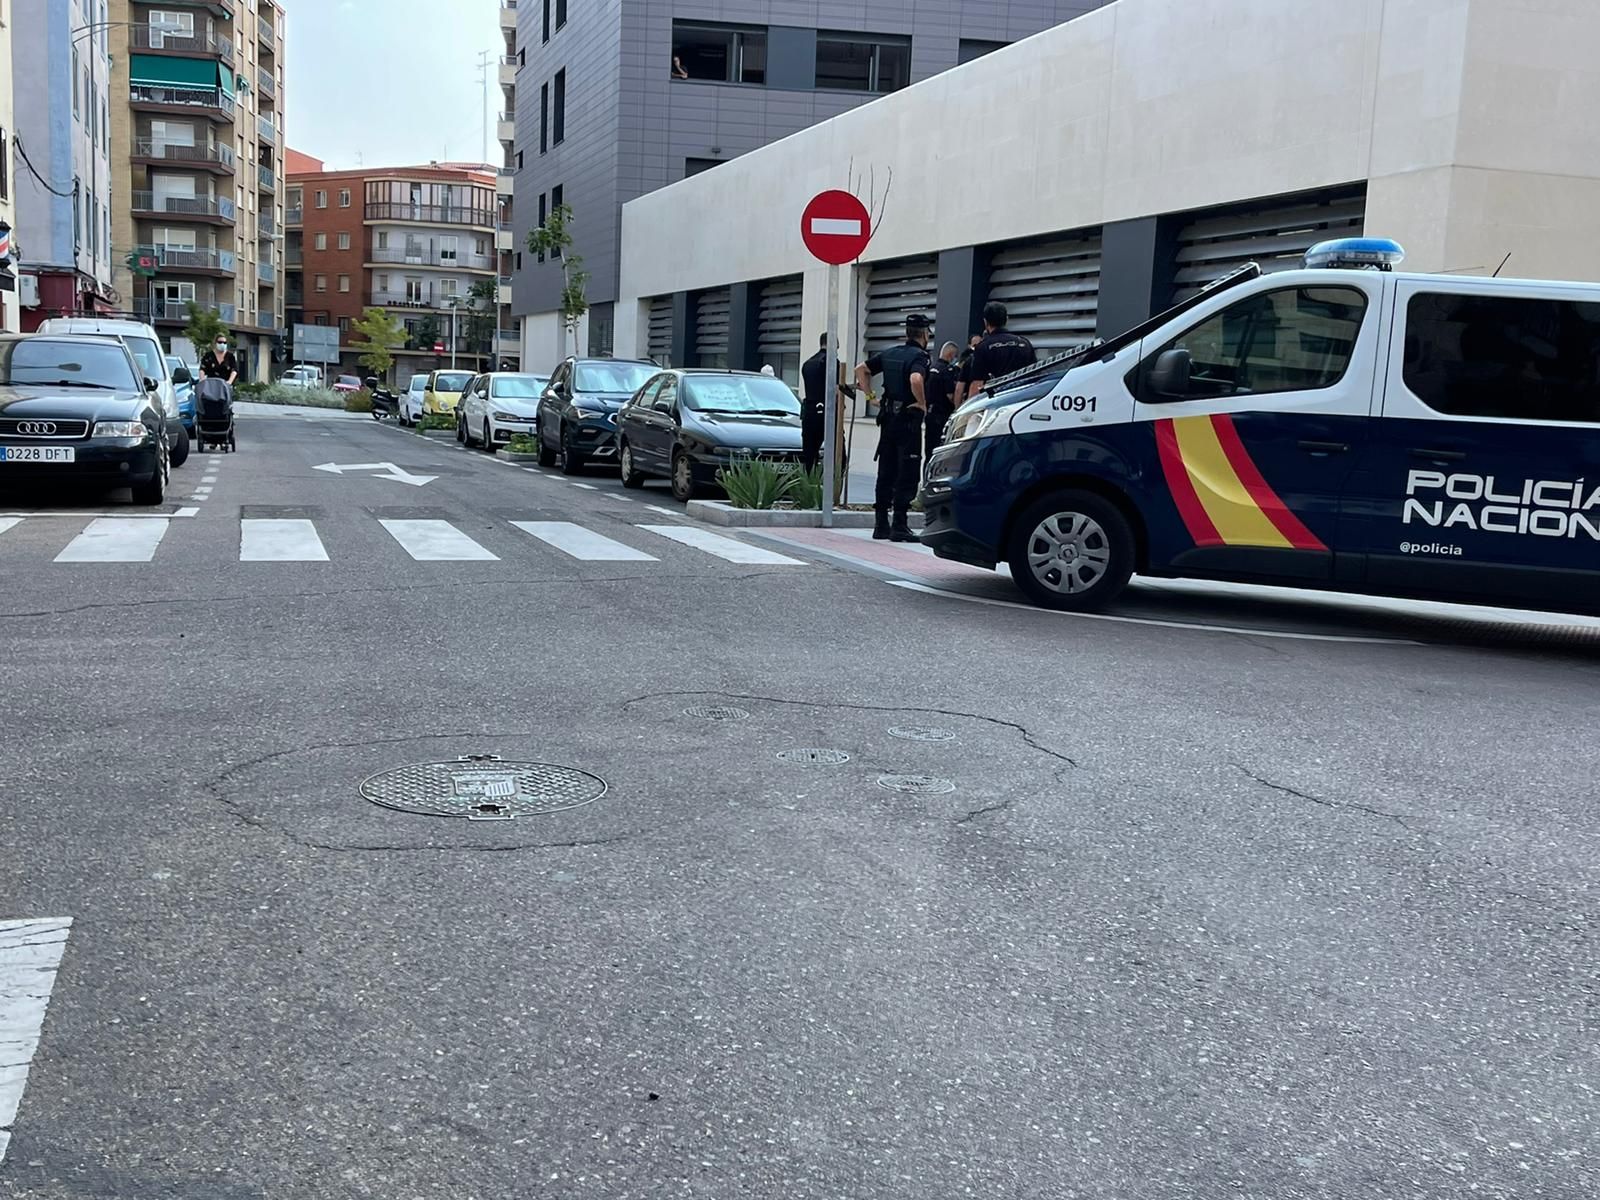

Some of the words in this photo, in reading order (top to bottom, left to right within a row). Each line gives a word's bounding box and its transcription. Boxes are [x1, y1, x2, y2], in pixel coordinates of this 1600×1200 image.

[1060, 395, 1097, 412] 091
[6, 448, 40, 460] 0228
[45, 448, 70, 460] DFT
[1400, 541, 1463, 555] @policia
